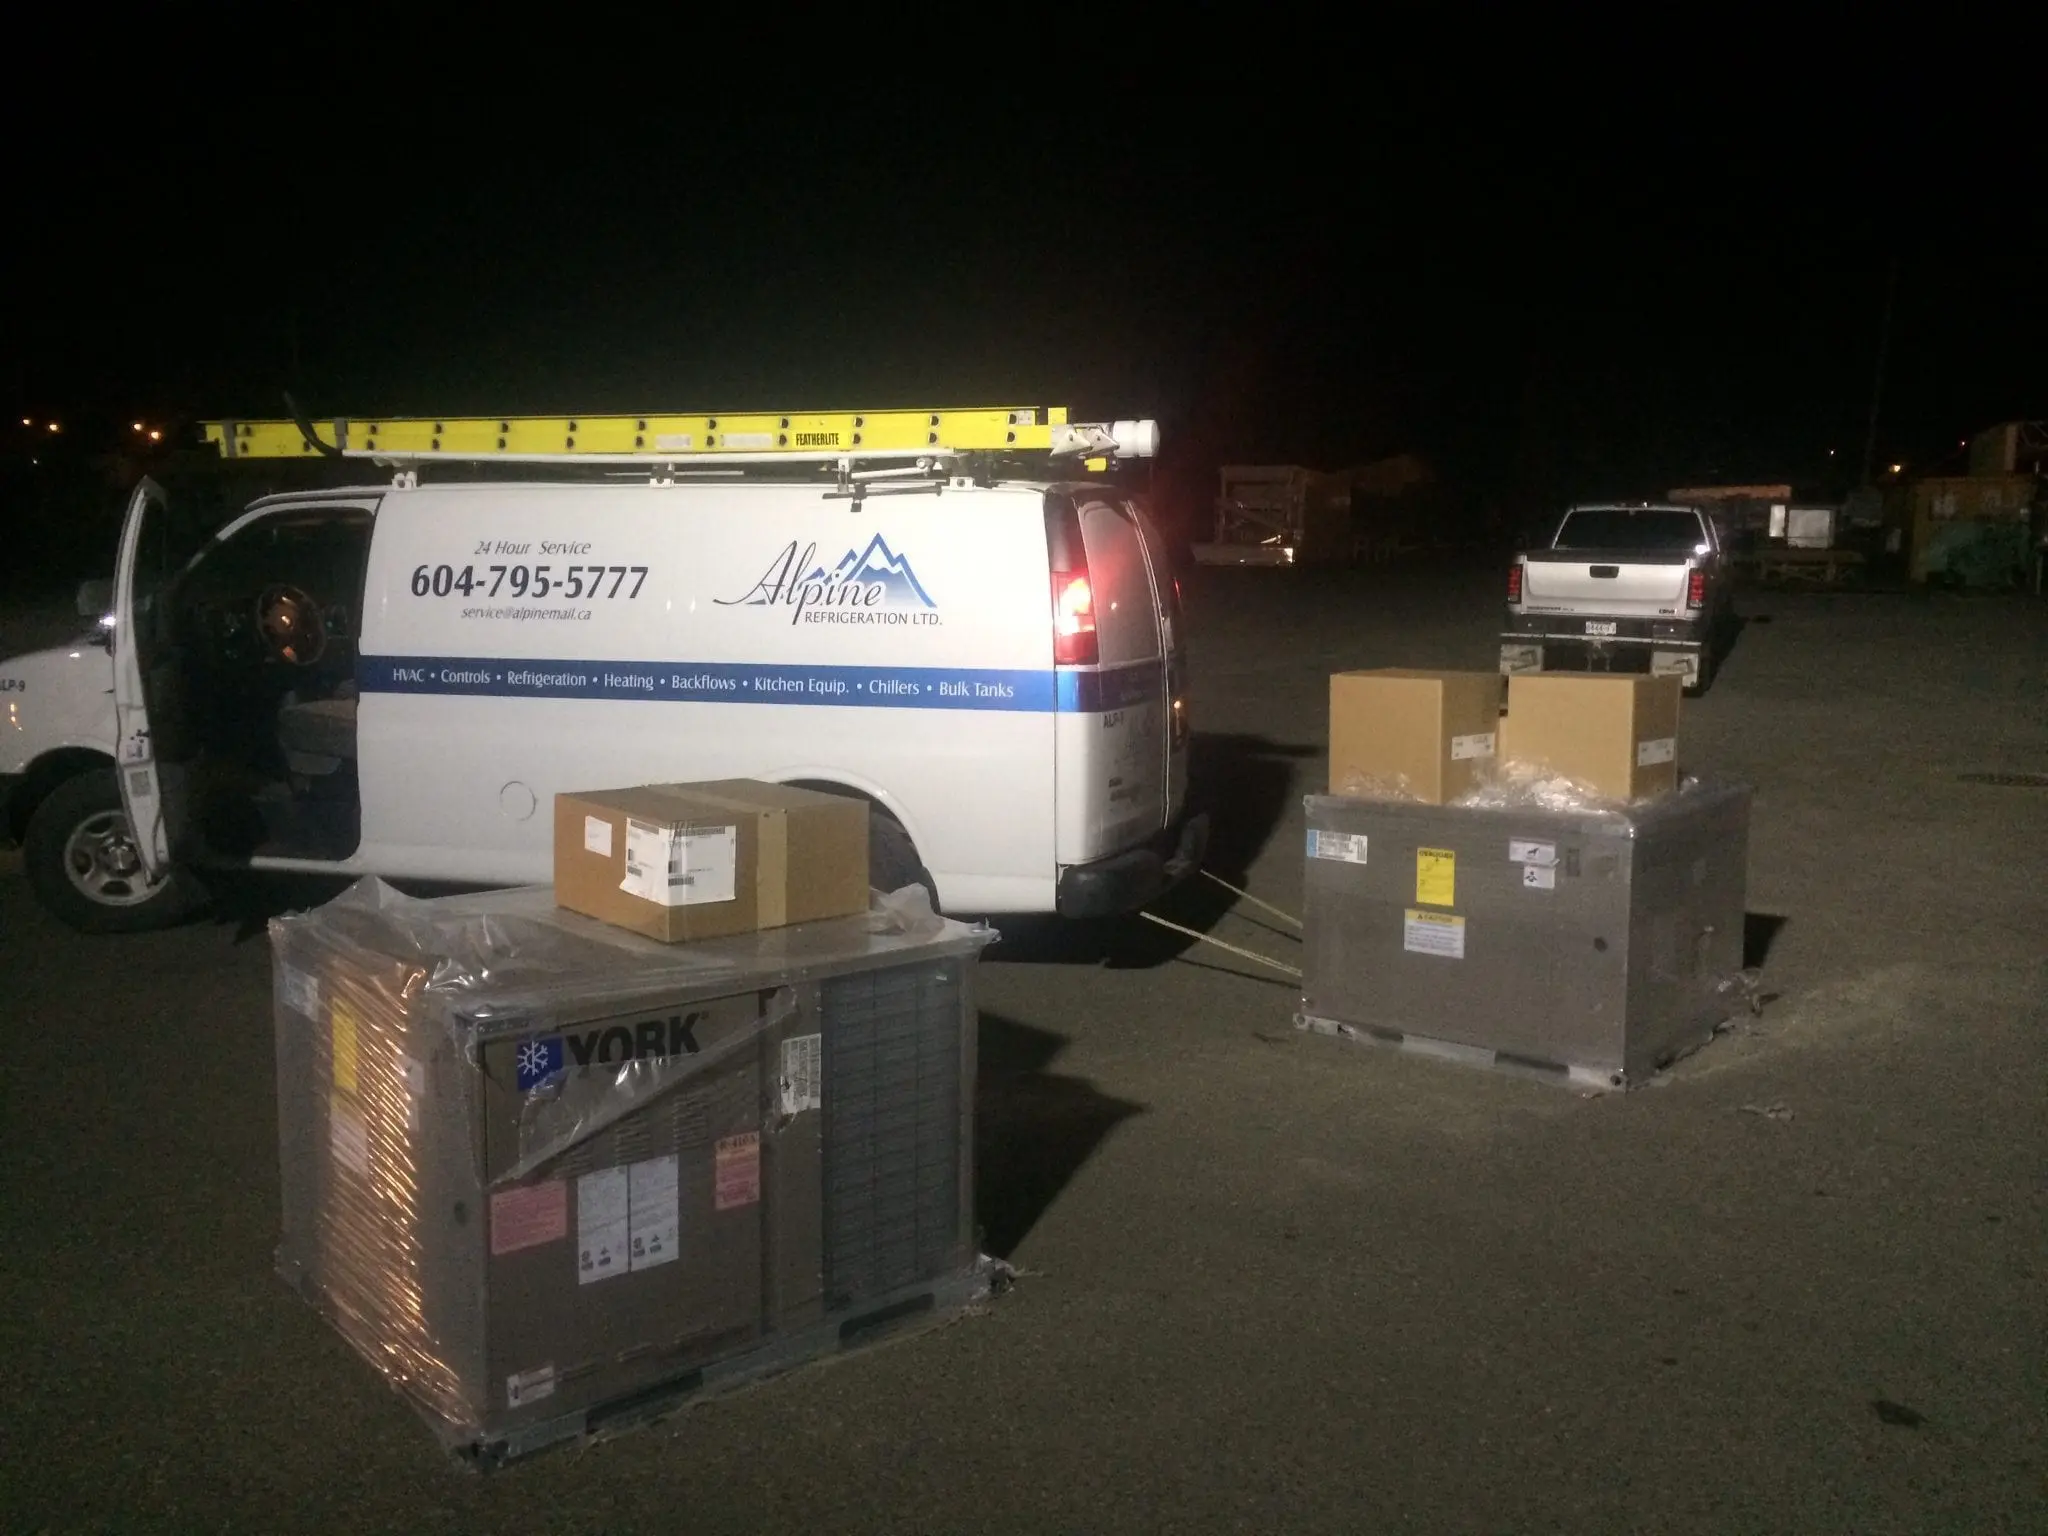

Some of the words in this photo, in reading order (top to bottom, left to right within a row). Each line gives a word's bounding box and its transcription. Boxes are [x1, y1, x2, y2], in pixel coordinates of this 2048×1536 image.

[796, 432, 839, 446] FEATHERLITE
[474, 541, 490, 555] 24
[495, 540, 531, 555] Hour
[538, 540, 592, 555] Service
[411, 564, 649, 599] 604-795-5777
[712, 540, 883, 626] Alpine
[461, 605, 592, 621] service@alpinemail.ca
[804, 611, 908, 625] REFRIGERATION
[912, 612, 943, 626] LTD.
[393, 668, 424, 682] HVAC
[440, 670, 491, 684] Controls
[507, 671, 587, 688] Refrigeration
[604, 674, 654, 691] Heating
[672, 674, 736, 691] Backflows
[754, 677, 804, 692] Kitchen
[808, 677, 849, 695] Equip.
[869, 679, 920, 695] Chillers
[939, 681, 970, 696] Bulk
[974, 682, 1014, 698] Tanks
[565, 1012, 700, 1070] YORK
